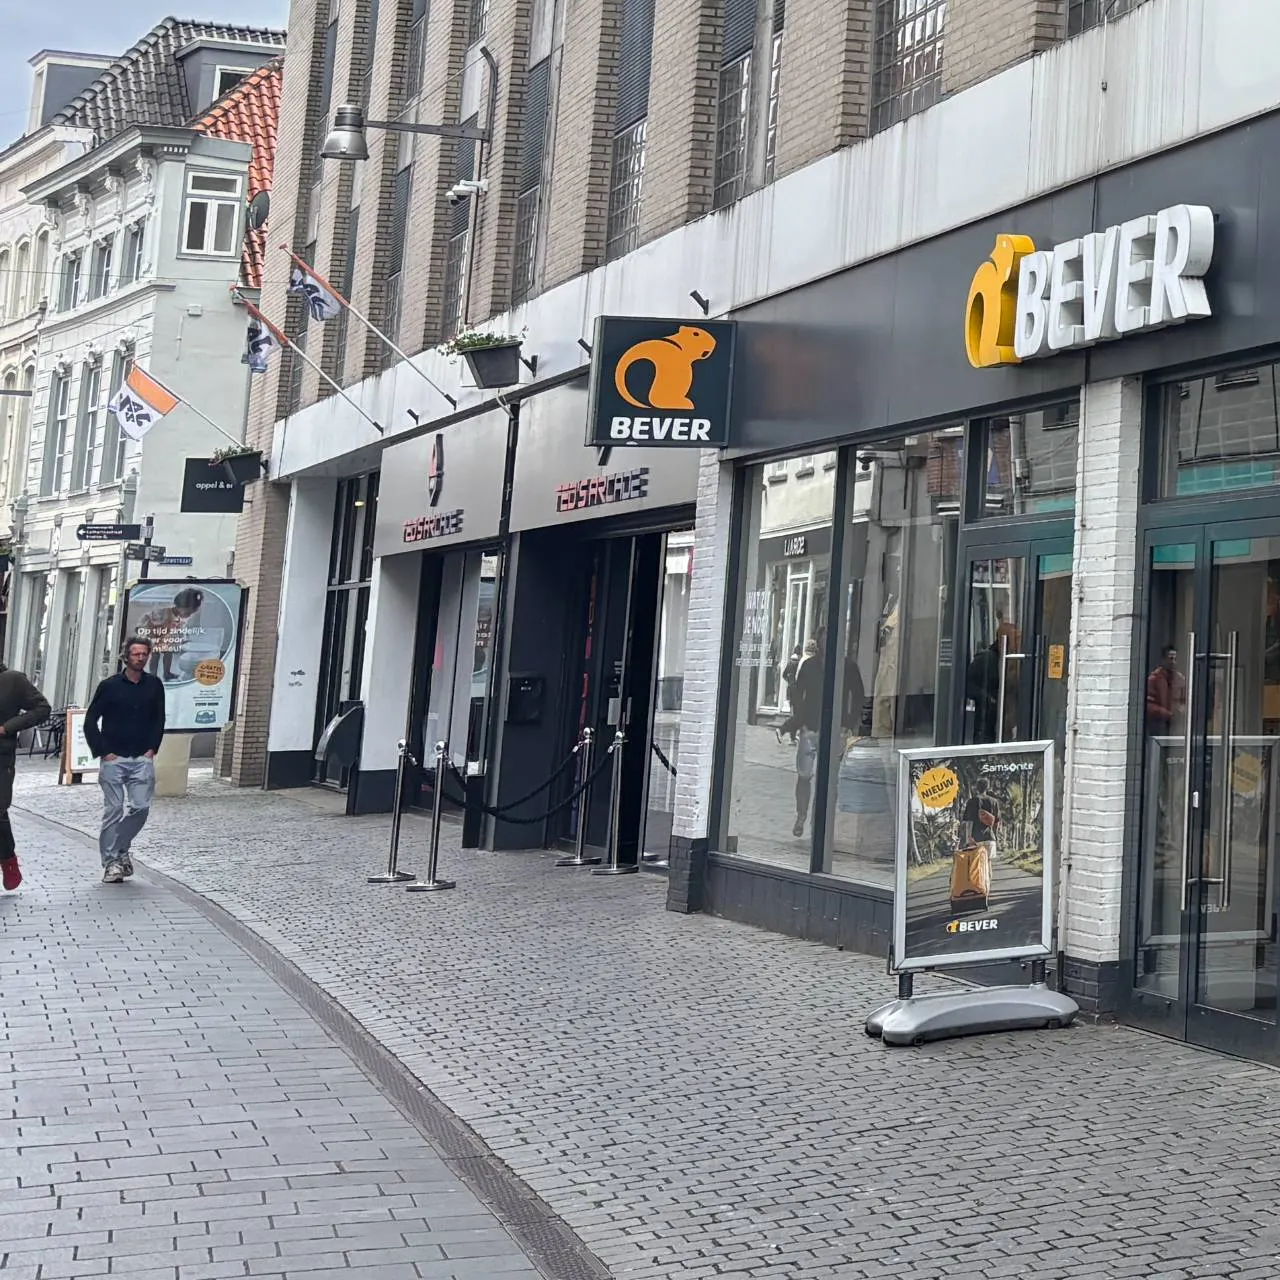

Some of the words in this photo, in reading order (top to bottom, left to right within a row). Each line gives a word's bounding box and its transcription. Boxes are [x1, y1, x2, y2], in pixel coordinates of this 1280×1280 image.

[1014, 203, 1215, 359] BEVER
[610, 416, 711, 441] BEVER
[195, 481, 217, 491] appel
[137, 627, 151, 638] Op
[152, 627, 168, 636] tijd
[169, 626, 206, 636] zindelijk
[920, 777, 955, 799] NIEUW
[958, 918, 998, 932] BEVER
